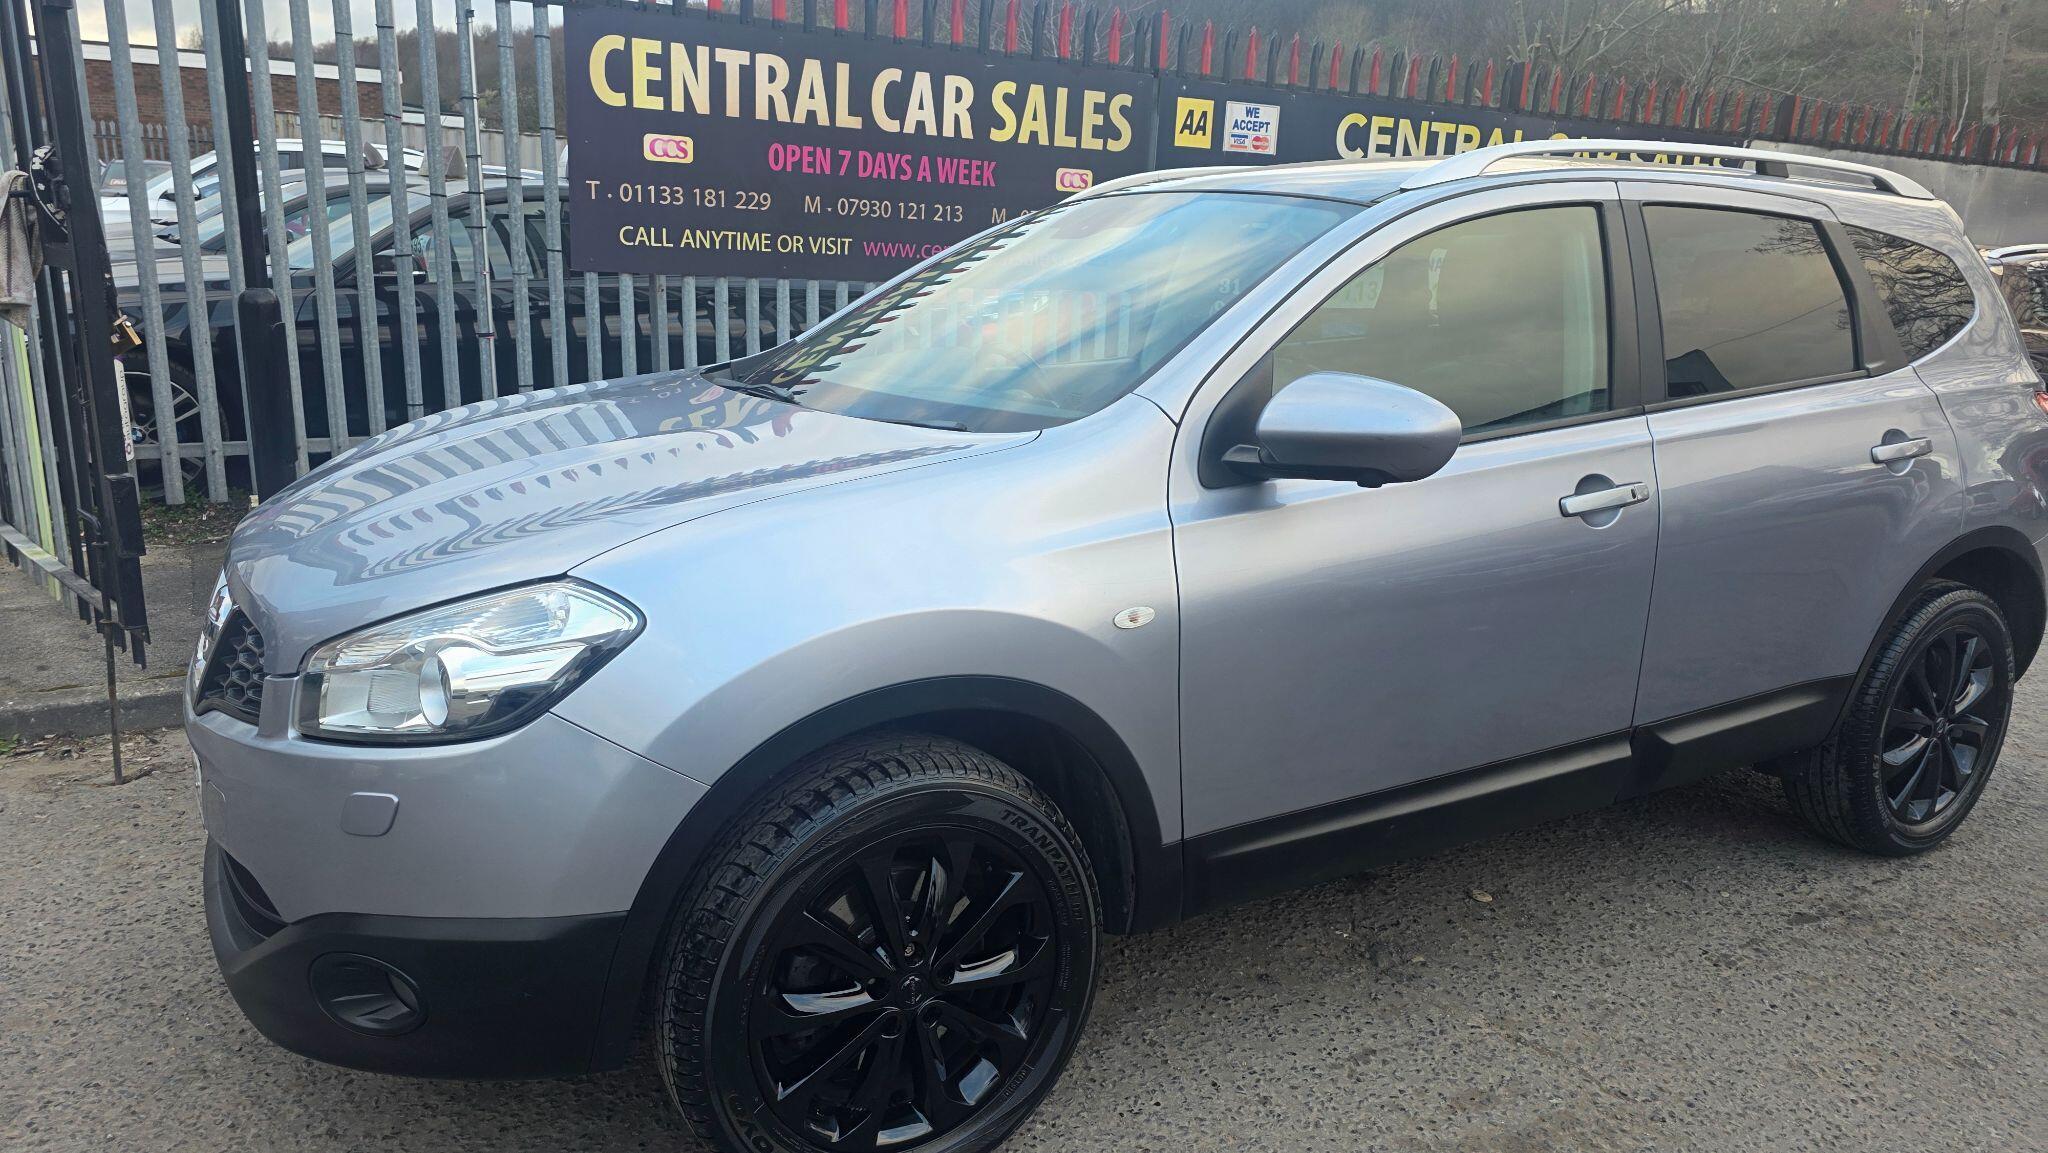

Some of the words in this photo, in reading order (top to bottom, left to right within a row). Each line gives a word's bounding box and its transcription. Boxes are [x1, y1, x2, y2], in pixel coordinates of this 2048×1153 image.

[589, 34, 863, 130] CENTRAL
[871, 67, 975, 140] CAR
[989, 80, 1134, 152] SALES
[1179, 109, 1209, 136] AA
[1245, 106, 1261, 119] WE
[1232, 119, 1271, 133] ACCEPT
[649, 137, 690, 160] CCS
[1232, 138, 1246, 146] VISA
[768, 142, 831, 176] OPEN
[838, 149, 852, 177] 7
[857, 150, 913, 182] DAYS
[917, 155, 932, 183] A
[937, 156, 998, 188] WEEK
[1060, 171, 1089, 189] CCS
[619, 182, 685, 206] 01133
[693, 187, 726, 208] 181
[734, 190, 772, 211] 229
[837, 197, 892, 219] 07930
[898, 202, 927, 221] 121
[933, 204, 964, 223] 213
[619, 225, 674, 248] CALL
[680, 228, 772, 253] ANYTIME
[777, 234, 804, 254] OR
[808, 236, 853, 256] VISIT
[863, 241, 951, 260] www.ce
